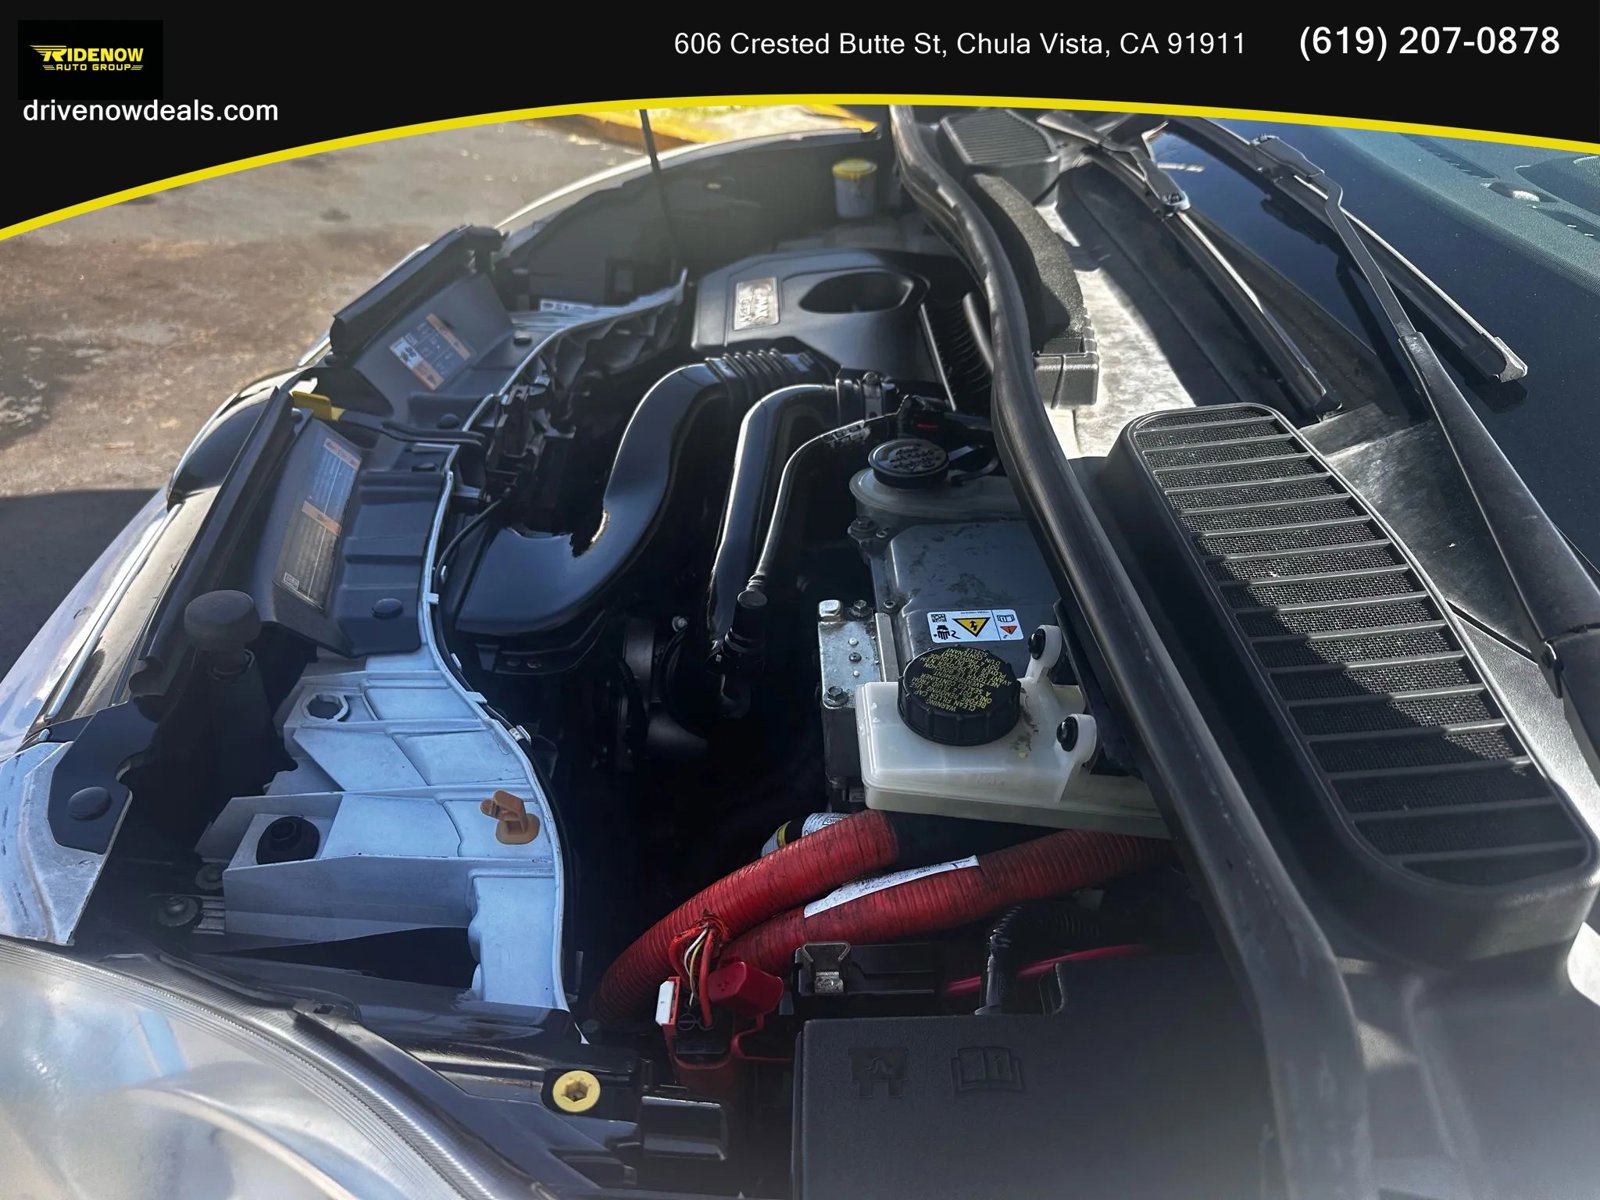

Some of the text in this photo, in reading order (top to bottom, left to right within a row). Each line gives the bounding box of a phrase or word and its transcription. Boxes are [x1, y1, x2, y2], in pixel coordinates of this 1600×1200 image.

[961, 696, 986, 708] BEFORE
[974, 694, 992, 704] ONLY
[953, 700, 976, 711] CLEAN
